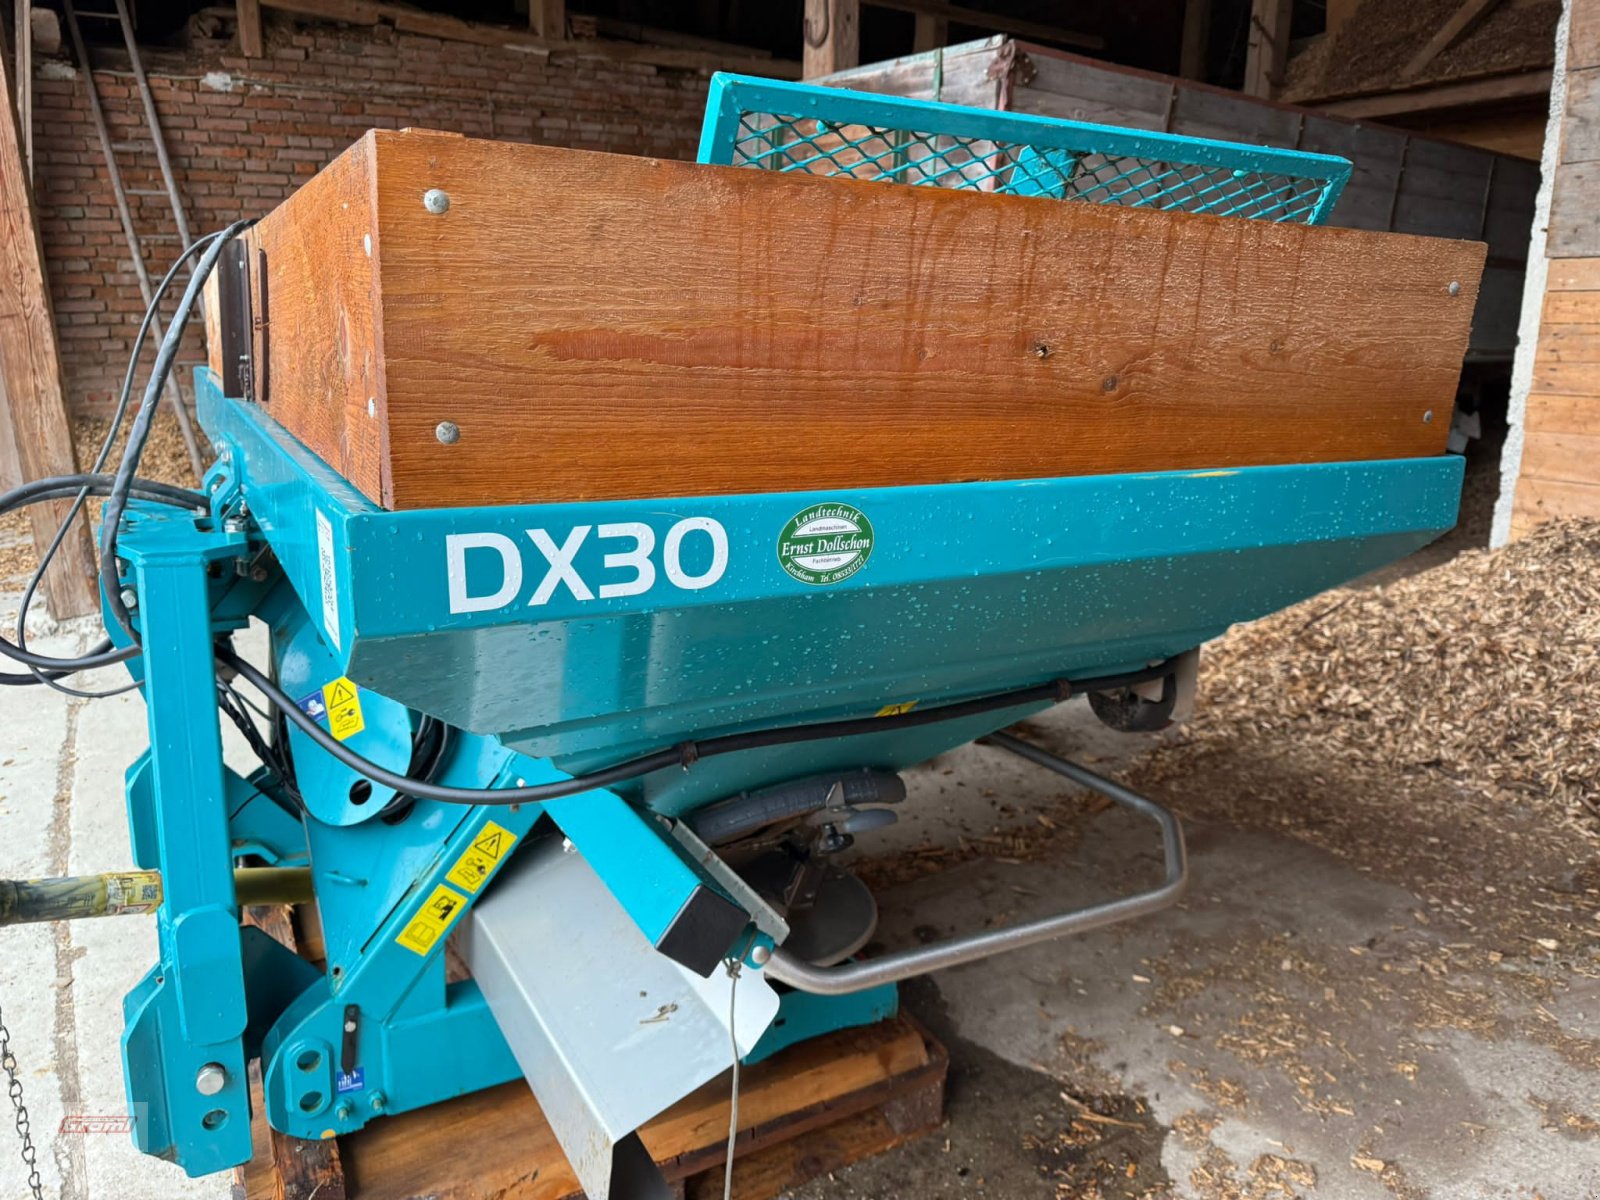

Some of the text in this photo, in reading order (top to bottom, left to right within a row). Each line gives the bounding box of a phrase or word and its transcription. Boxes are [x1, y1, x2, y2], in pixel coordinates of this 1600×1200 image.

[795, 506, 861, 527] Landtechnik
[782, 534, 870, 557] Ernst Dollschon
[445, 516, 729, 614] DX30
[785, 562, 815, 582] Kirchham
[820, 574, 831, 582] Tel.
